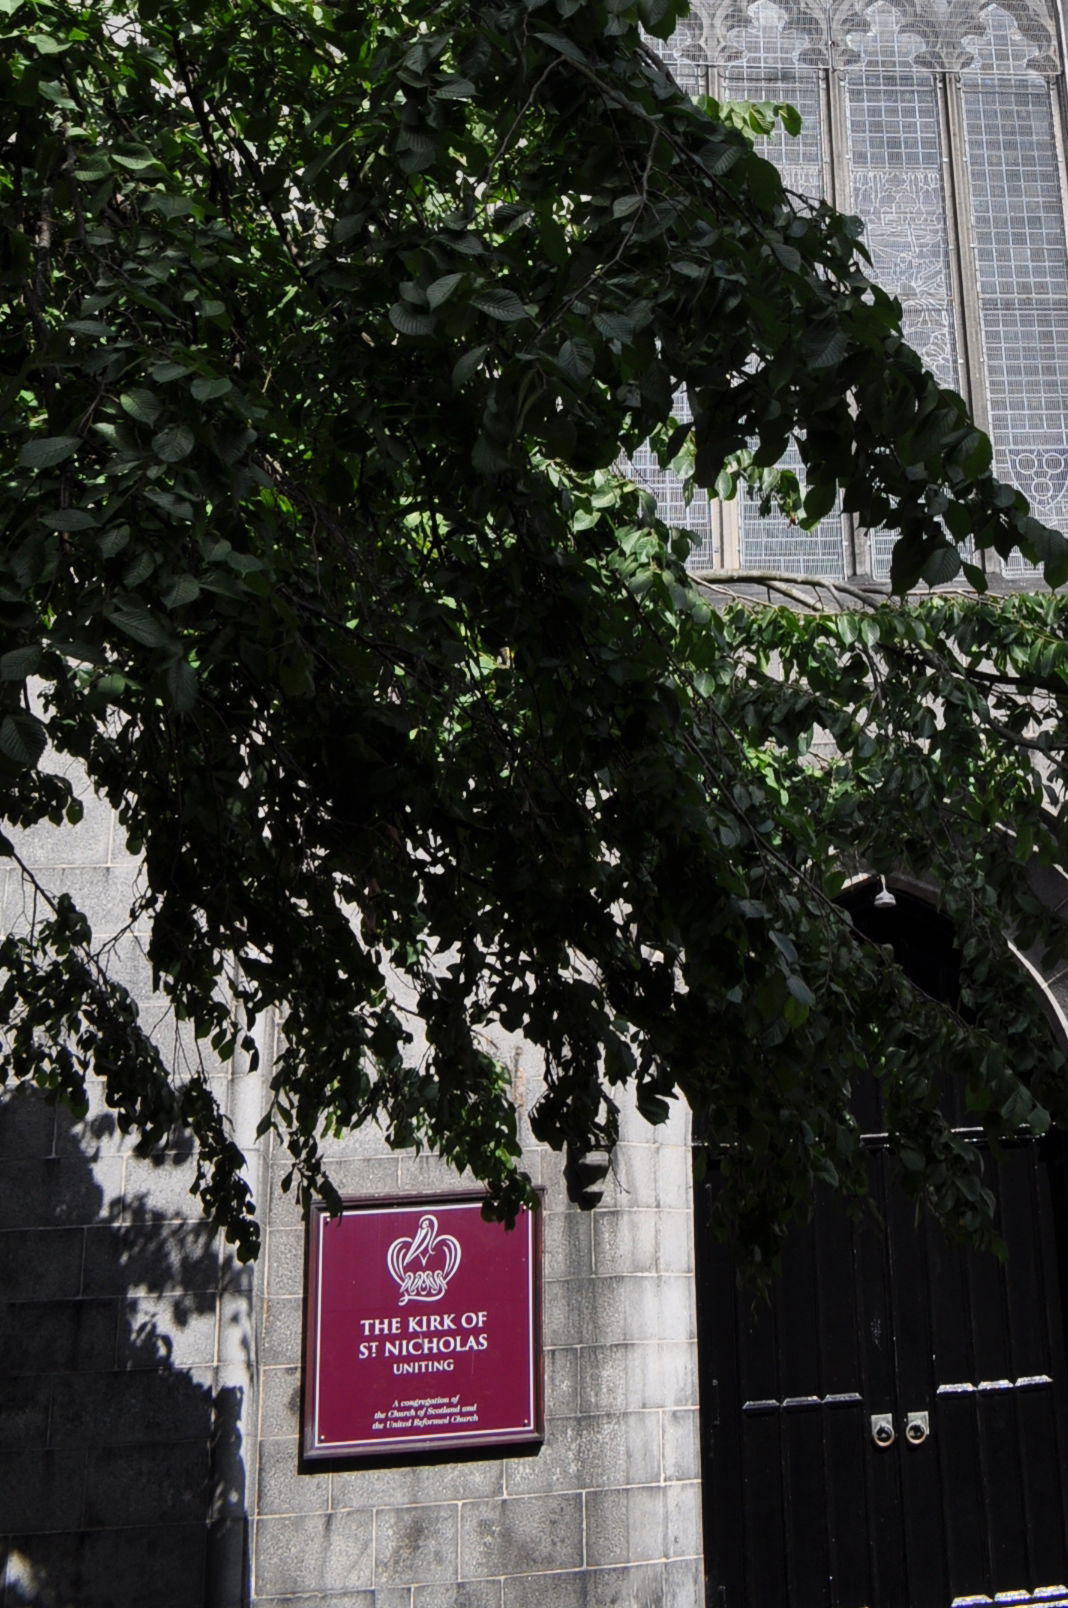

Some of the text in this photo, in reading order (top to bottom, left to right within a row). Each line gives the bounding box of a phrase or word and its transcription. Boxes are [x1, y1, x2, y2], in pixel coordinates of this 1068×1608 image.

[360, 1311, 488, 1336] THE KIRK OF
[384, 1333, 488, 1357] NICHOLAS
[393, 1359, 455, 1375] UNITING
[392, 1394, 461, 1408] A congregation of
[374, 1403, 477, 1419] the Church of Scotland and
[372, 1414, 479, 1430] the United Reformed Church
